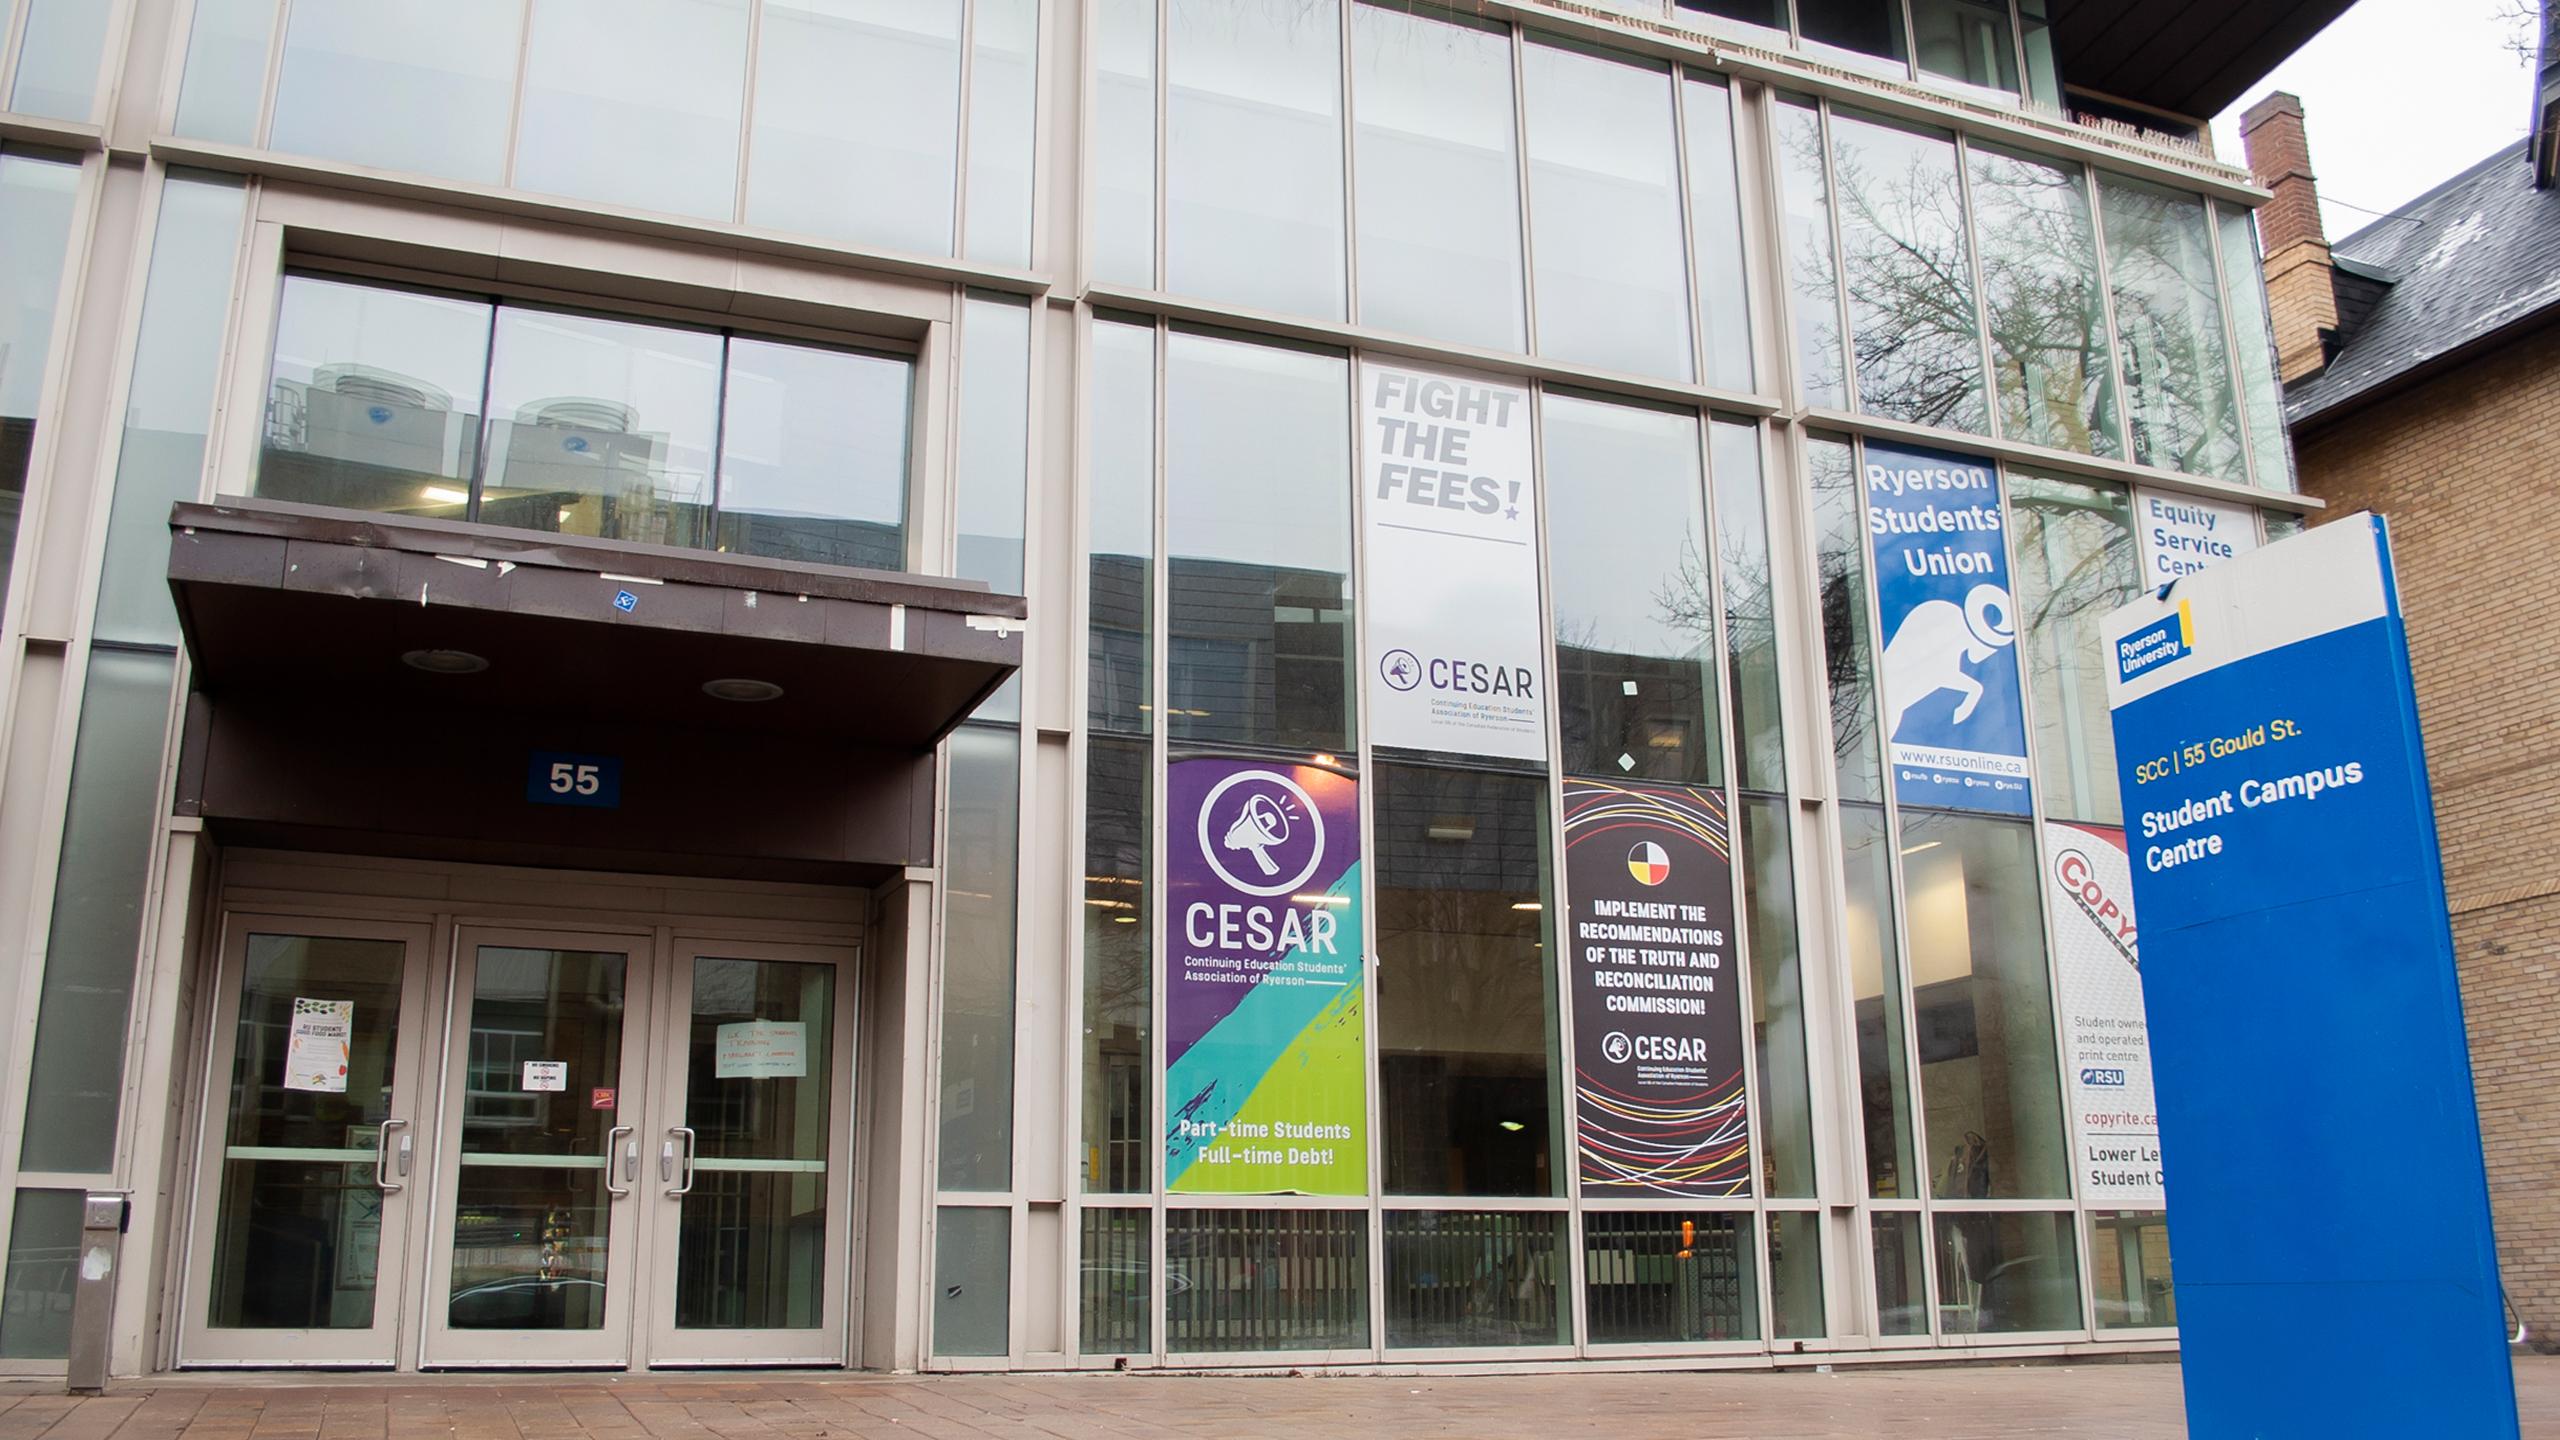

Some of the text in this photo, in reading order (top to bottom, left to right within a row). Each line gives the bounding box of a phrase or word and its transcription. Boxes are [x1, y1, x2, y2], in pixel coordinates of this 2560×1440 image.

[1375, 373, 1519, 428] FIGHT
[1377, 417, 1470, 466] THE
[1866, 464, 1988, 496] Ryerson
[1377, 463, 1521, 521] FEES!
[2150, 499, 2216, 531] Equity
[2154, 528, 2232, 558] Service
[1904, 546, 1994, 576] Union
[2120, 629, 2167, 658] Ryerson
[2123, 641, 2179, 673] University
[1430, 658, 1533, 698] CESAR
[1431, 699, 1467, 710] Continuing
[1469, 702, 1501, 712] Education
[1432, 708, 1471, 718] Association
[1481, 713, 1508, 722] Ryerson
[1900, 751, 2022, 773] www.rsuonline.ca
[2136, 757, 2169, 784] SCC
[2184, 742, 2206, 768] 55
[2210, 725, 2266, 759] Gould
[2270, 719, 2301, 741] St.
[550, 763, 599, 795] 55
[2141, 761, 2363, 838] Student Campus
[2146, 834, 2223, 872] Centre
[1594, 899, 1707, 922] IMPLEMENT THE
[2062, 857, 2137, 948] COPY
[1185, 902, 1337, 954] CESAR
[1579, 922, 1723, 946] RECOMMENDATIONS
[1184, 955, 1347, 974] Continuing Education Students'
[1586, 946, 1720, 969] OF THE TRUTH AND
[1184, 970, 1305, 987] Association of Ryerson
[1595, 970, 1713, 992] RECONCILIATION
[1606, 995, 1706, 1015] COMMISSION!
[2074, 1016, 2147, 1030] Student owne
[1635, 1035, 1707, 1062] CESAR
[2077, 1033, 2144, 1046] and operated
[2079, 1050, 2139, 1062] print centre
[2095, 1070, 2123, 1084] RSU
[1180, 1119, 1351, 1139] Part-time Students
[2085, 1111, 2158, 1128] copyrite.ca
[1199, 1146, 1334, 1165] Full-time Debt!
[2089, 1145, 2160, 1161] Lower Le
[2091, 1170, 2151, 1186] Student
